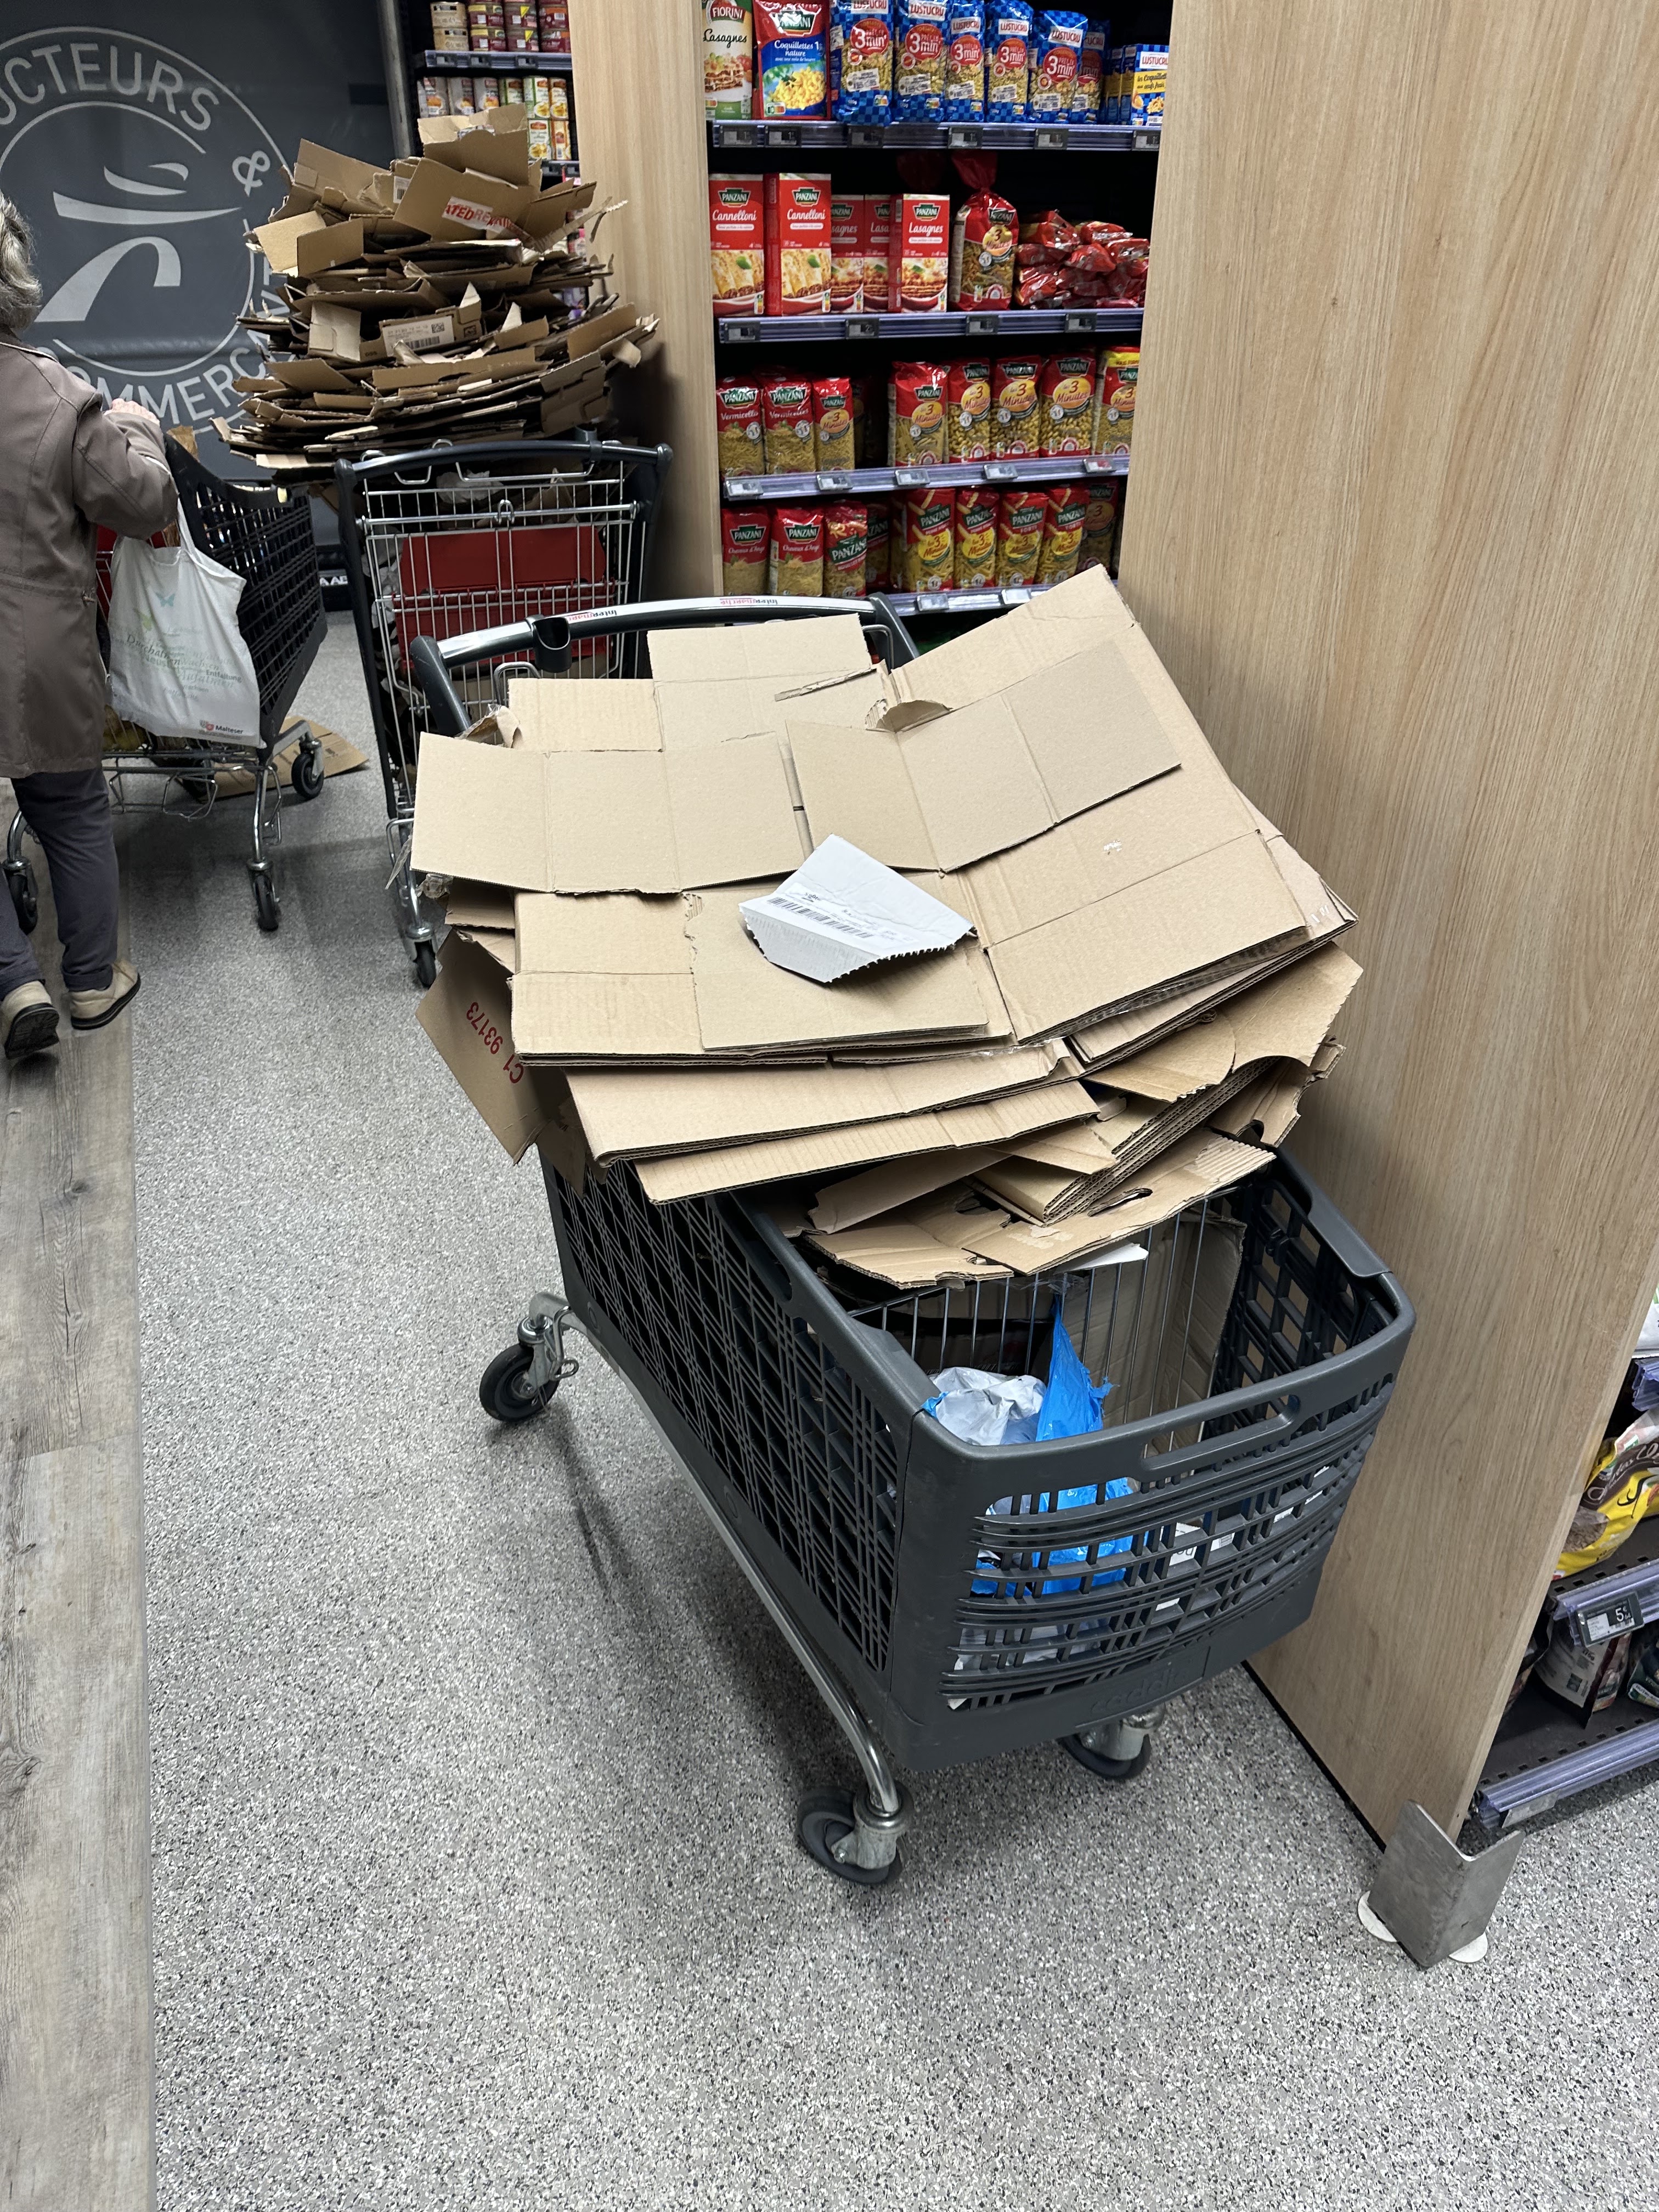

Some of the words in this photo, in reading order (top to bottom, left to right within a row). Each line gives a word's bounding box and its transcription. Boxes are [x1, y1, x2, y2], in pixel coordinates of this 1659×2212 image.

[712, 7, 743, 20] FIORINI
[910, 5, 944, 16] LUSTUCRU
[953, 21, 979, 31] LUSTUCRU
[1000, 22, 1028, 32] LUSTUCRU
[703, 29, 747, 48] Lasagnes
[855, 28, 865, 48] 3
[1052, 30, 1081, 43] LUSTUCRU
[774, 40, 813, 52] Coquillettes
[909, 33, 920, 53] 3
[954, 44, 964, 60] 3
[1000, 46, 1010, 63] 3
[1047, 55, 1058, 75] 3
[232, 150, 271, 196] &
[722, 193, 748, 203] PANZANI
[795, 192, 818, 203] PANZANI
[713, 210, 757, 221] Cannelloni
[787, 209, 826, 220] Cannelloni
[916, 208, 938, 217] PANZANI
[831, 225, 857, 236] sagnes
[909, 222, 944, 236] Lasagnes
[995, 229, 1002, 241] 3
[1005, 366, 1036, 376] PANZANI
[1060, 362, 1087, 371] PANZANI
[976, 385, 984, 399] 3
[1017, 383, 1028, 396] 3
[1069, 380, 1080, 393] 3
[724, 391, 754, 403] PANZANI
[773, 390, 804, 402] PANZANI
[1057, 392, 1088, 404] Minutes
[1125, 388, 1133, 399] 3
[927, 404, 934, 415] 3
[833, 413, 840, 421] 3
[921, 507, 950, 527] PANZANI
[1013, 510, 1043, 524] PANZANI
[735, 530, 762, 540] PANZANI
[789, 528, 817, 537] PANZANI
[934, 536, 940, 548] 3
[979, 534, 985, 546] 3
[216, 725, 244, 734] Malteser
[466, 1002, 503, 1054] 93173
[503, 1053, 524, 1084] C1
